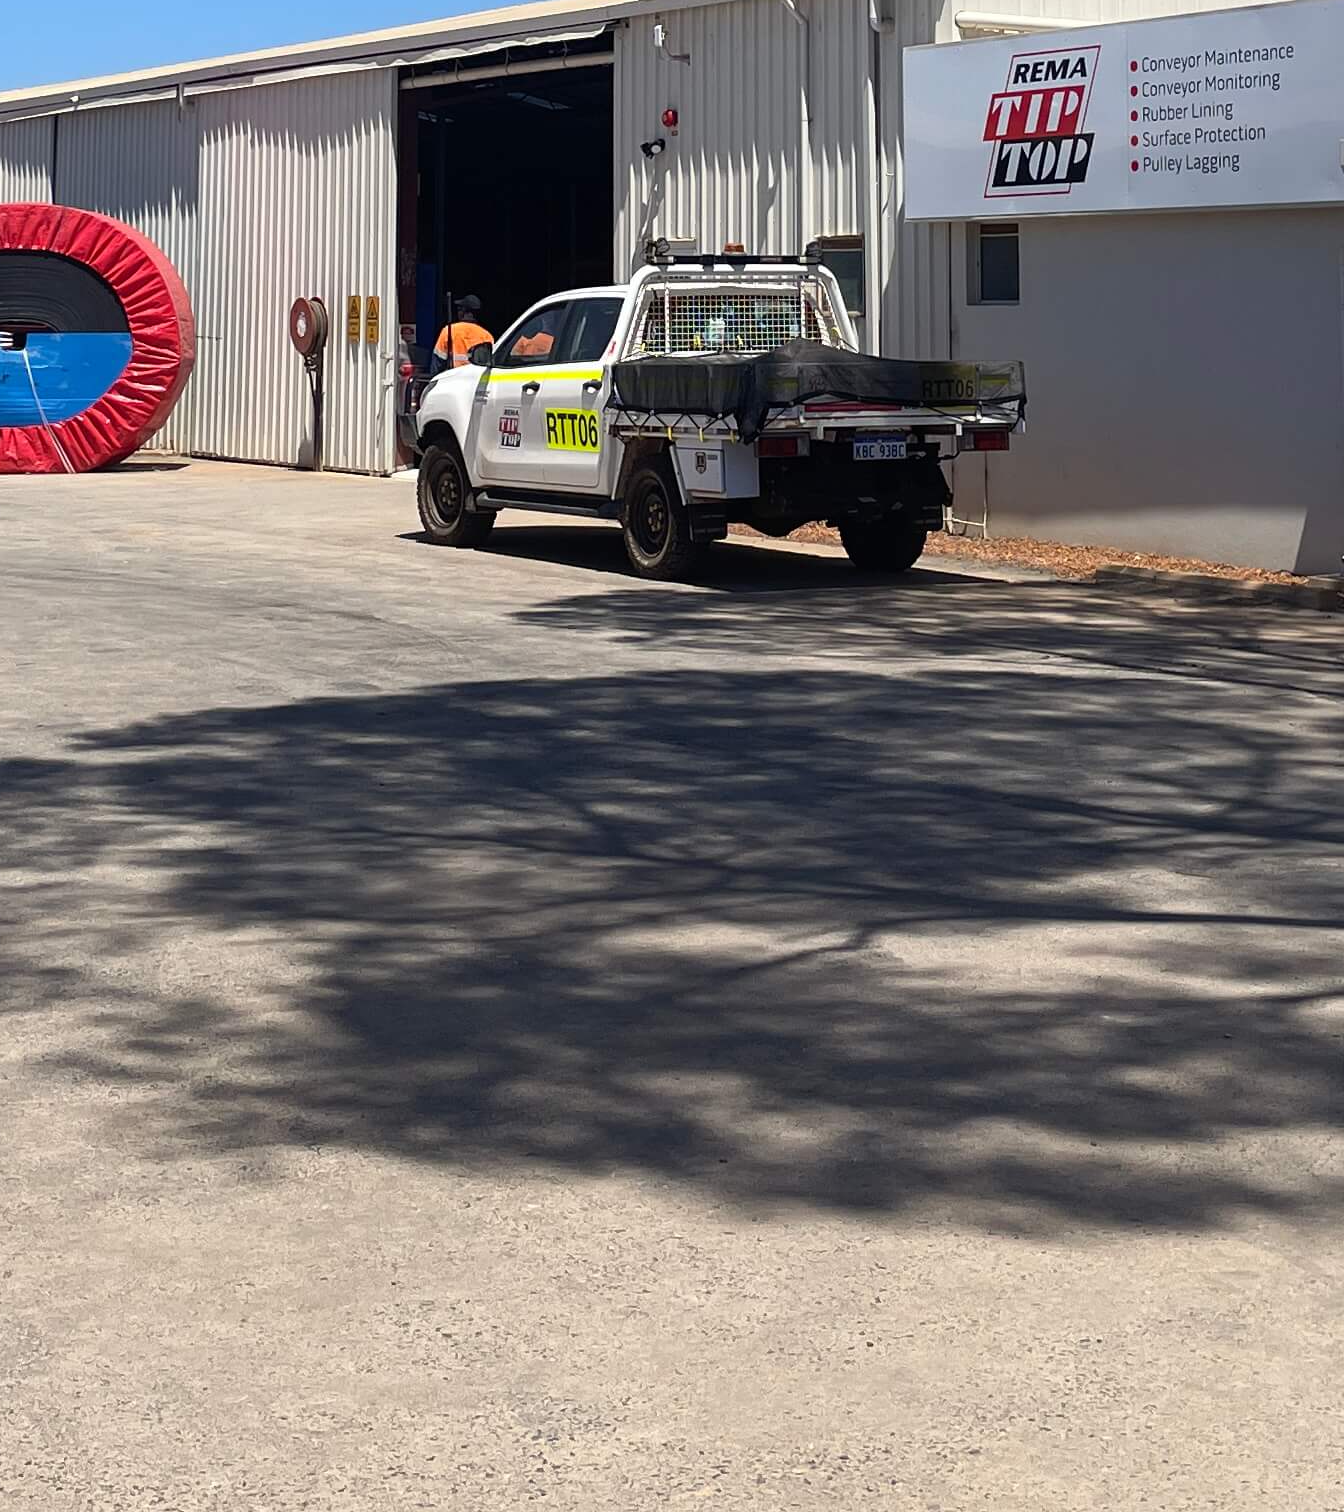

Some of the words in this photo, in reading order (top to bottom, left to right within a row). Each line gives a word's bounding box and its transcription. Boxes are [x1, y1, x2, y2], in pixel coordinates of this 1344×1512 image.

[1013, 57, 1087, 84] REMA
[1142, 54, 1202, 73] Conveyor
[1205, 45, 1294, 66] Maintenance
[1142, 79, 1202, 98] Conveyor
[1206, 72, 1281, 91] Monitoring
[992, 90, 1079, 137] TIP
[1142, 105, 1188, 122] Rubber
[1192, 101, 1233, 120] Lining
[1143, 130, 1192, 147] Surface
[1195, 125, 1266, 144] Protection
[1001, 138, 1088, 182] TOP
[1143, 156, 1183, 175] Pulley
[1186, 152, 1240, 174] Lagging
[922, 379, 974, 398] RTT06
[546, 412, 598, 448] RTT06
[856, 444, 875, 458] KBC
